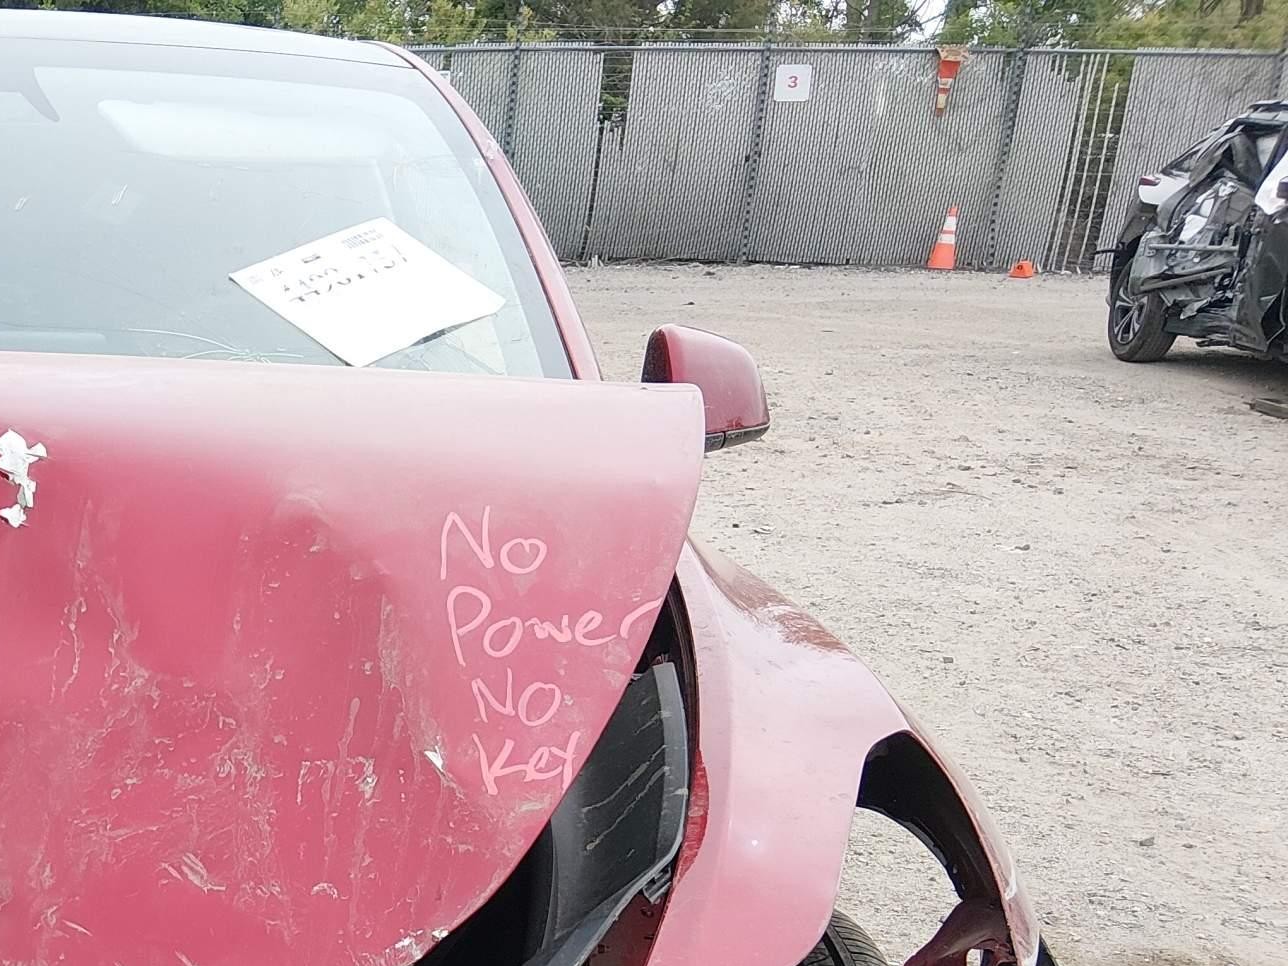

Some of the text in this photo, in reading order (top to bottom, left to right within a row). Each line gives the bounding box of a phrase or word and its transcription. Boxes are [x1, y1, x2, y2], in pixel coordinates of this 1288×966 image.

[787, 75, 799, 88] 3
[440, 505, 548, 580] No
[447, 585, 663, 667] Power
